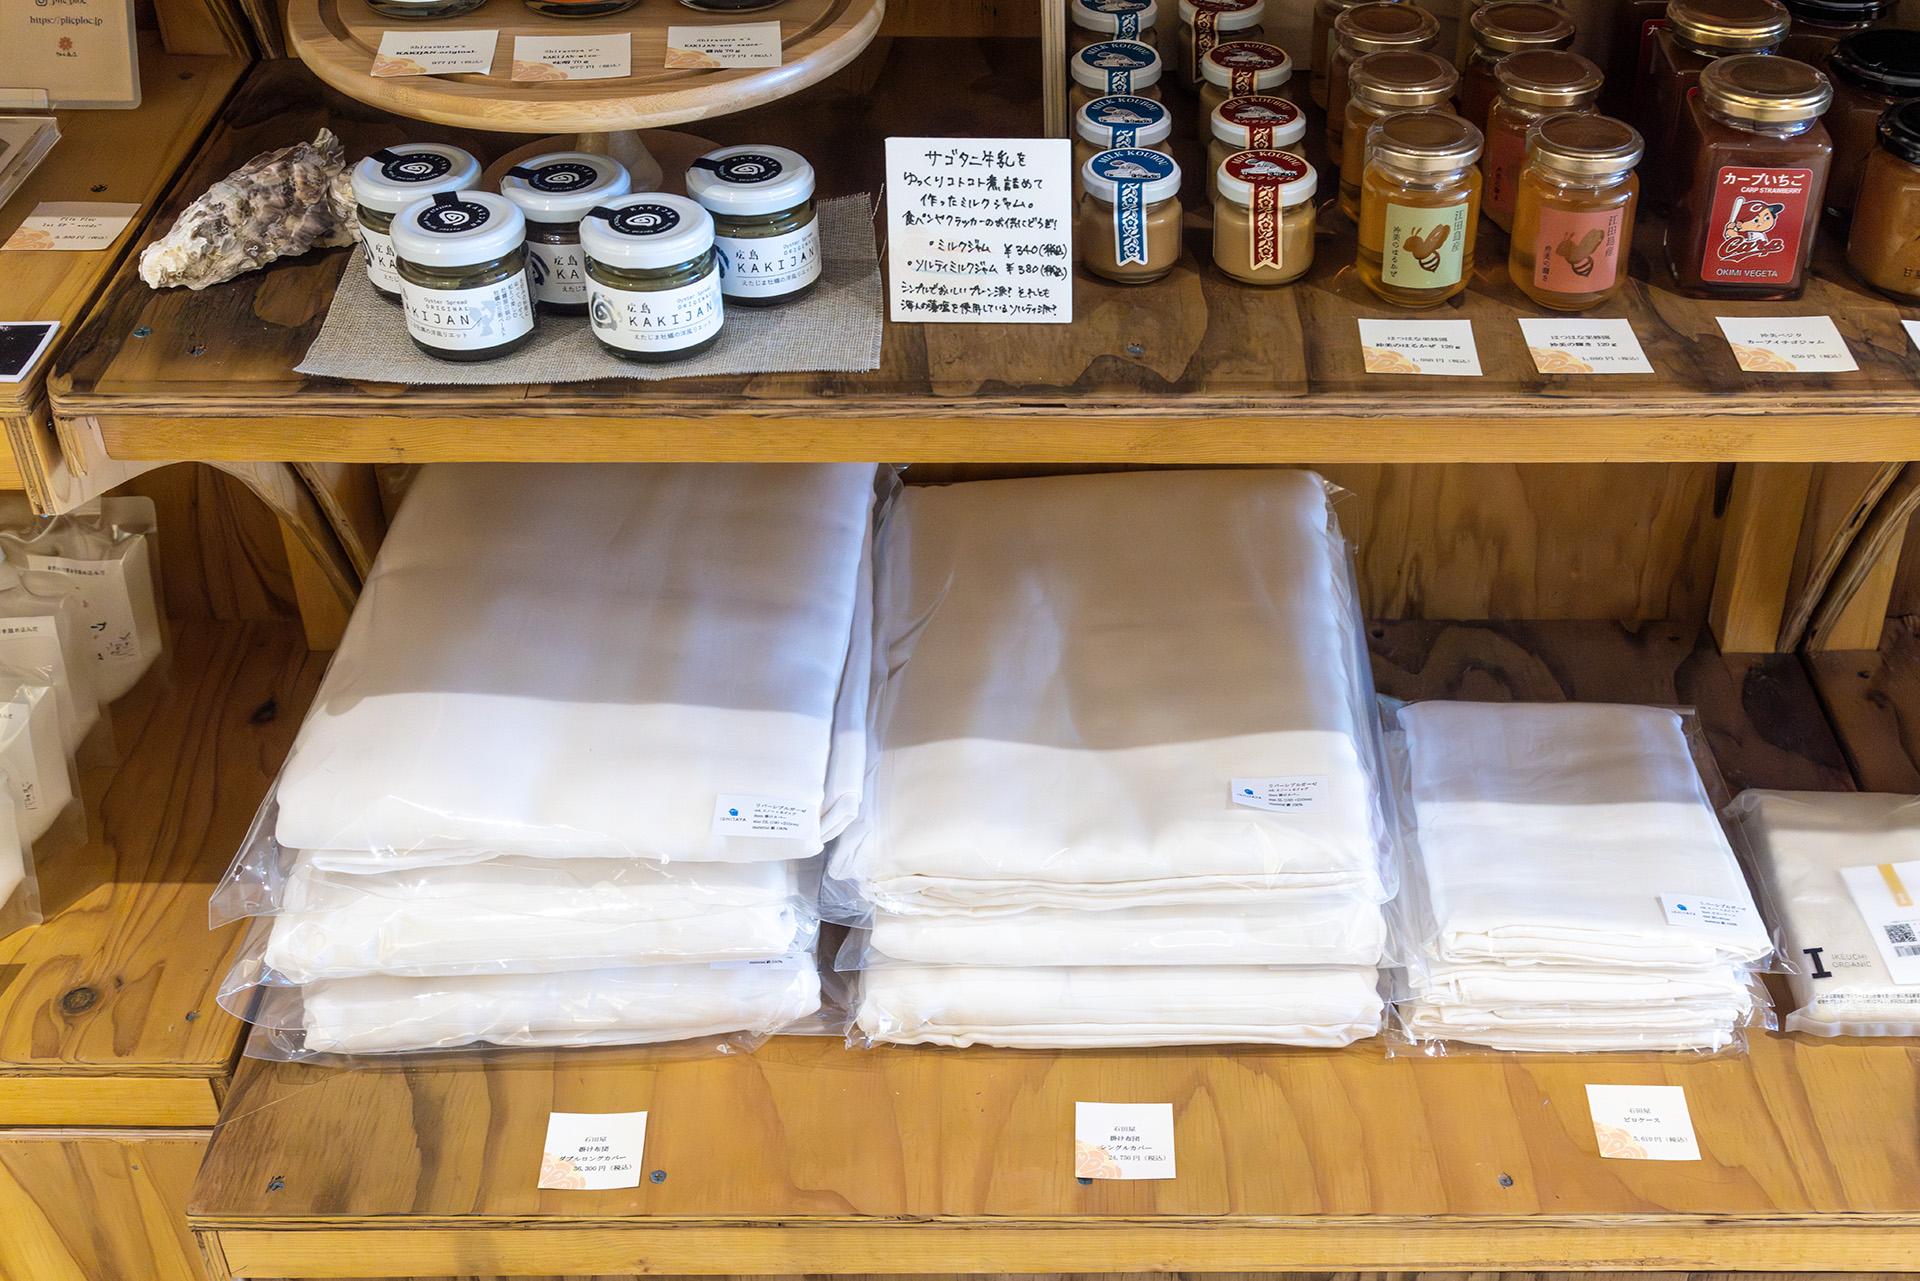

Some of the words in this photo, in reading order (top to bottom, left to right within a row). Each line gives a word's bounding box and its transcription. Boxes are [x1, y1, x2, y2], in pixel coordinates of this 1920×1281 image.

[1091, 99, 1115, 110] MILK
[1118, 97, 1158, 111] KOUBOU
[924, 149, 1027, 168] サゴタニ牛乳を
[1098, 151, 1124, 164] MILK
[1127, 150, 1169, 165] KOUBOU
[1231, 153, 1255, 164] MILK
[1260, 151, 1301, 166] KOUBOU
[903, 172, 1043, 191] ゆっくりコトコト煮詰めて
[1723, 172, 1805, 187] カープいちご
[920, 193, 1034, 209] 作ったミルクジャム。
[737, 246, 814, 274] KAKIJAN
[1716, 268, 1742, 276] OKIMI
[1744, 269, 1778, 277] VEGETA
[629, 301, 713, 328] KAKIJAN
